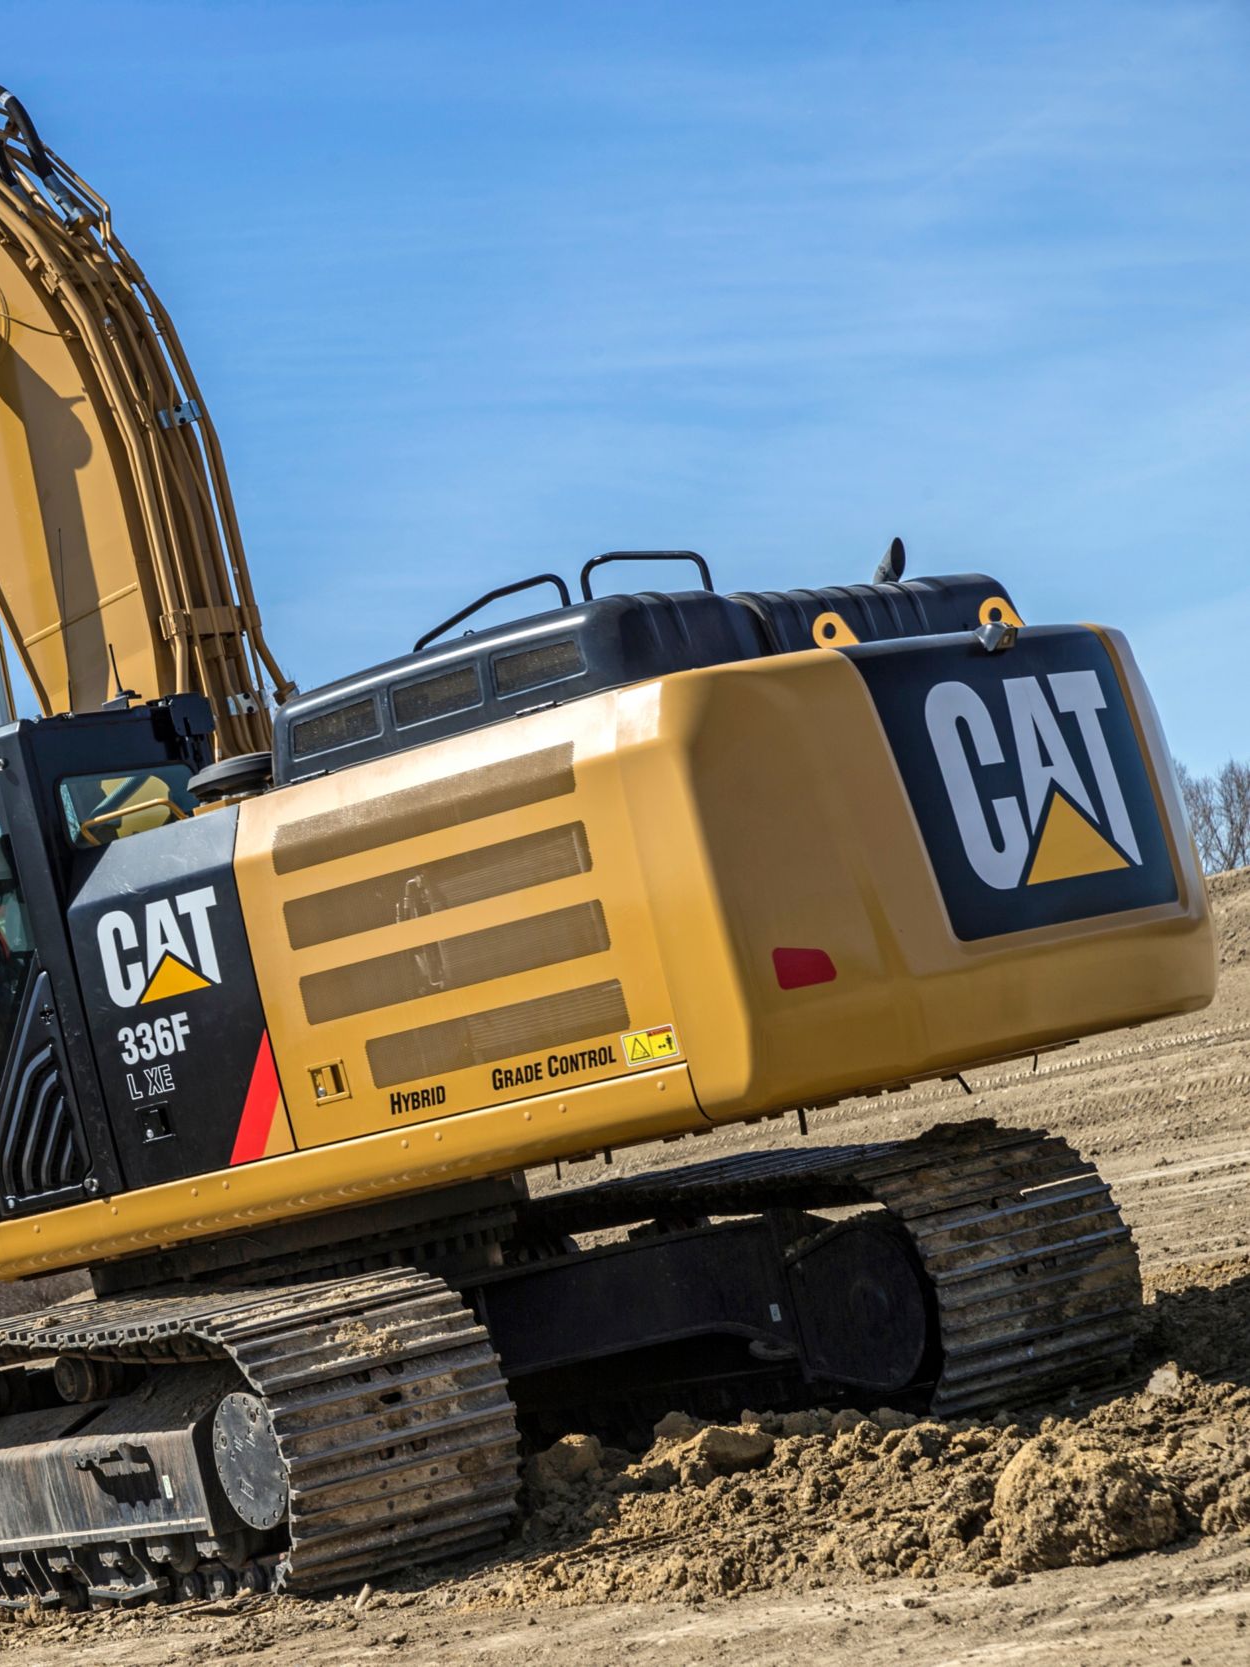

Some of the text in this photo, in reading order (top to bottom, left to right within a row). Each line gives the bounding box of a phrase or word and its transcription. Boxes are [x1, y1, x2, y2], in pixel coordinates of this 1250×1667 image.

[924, 669, 1144, 890] CAT
[96, 885, 222, 1008] CAT
[117, 1011, 191, 1065] 336F
[126, 1064, 175, 1100] L XE
[491, 1045, 617, 1091] GRADE CONTROL
[390, 1085, 446, 1115] HYBRID
